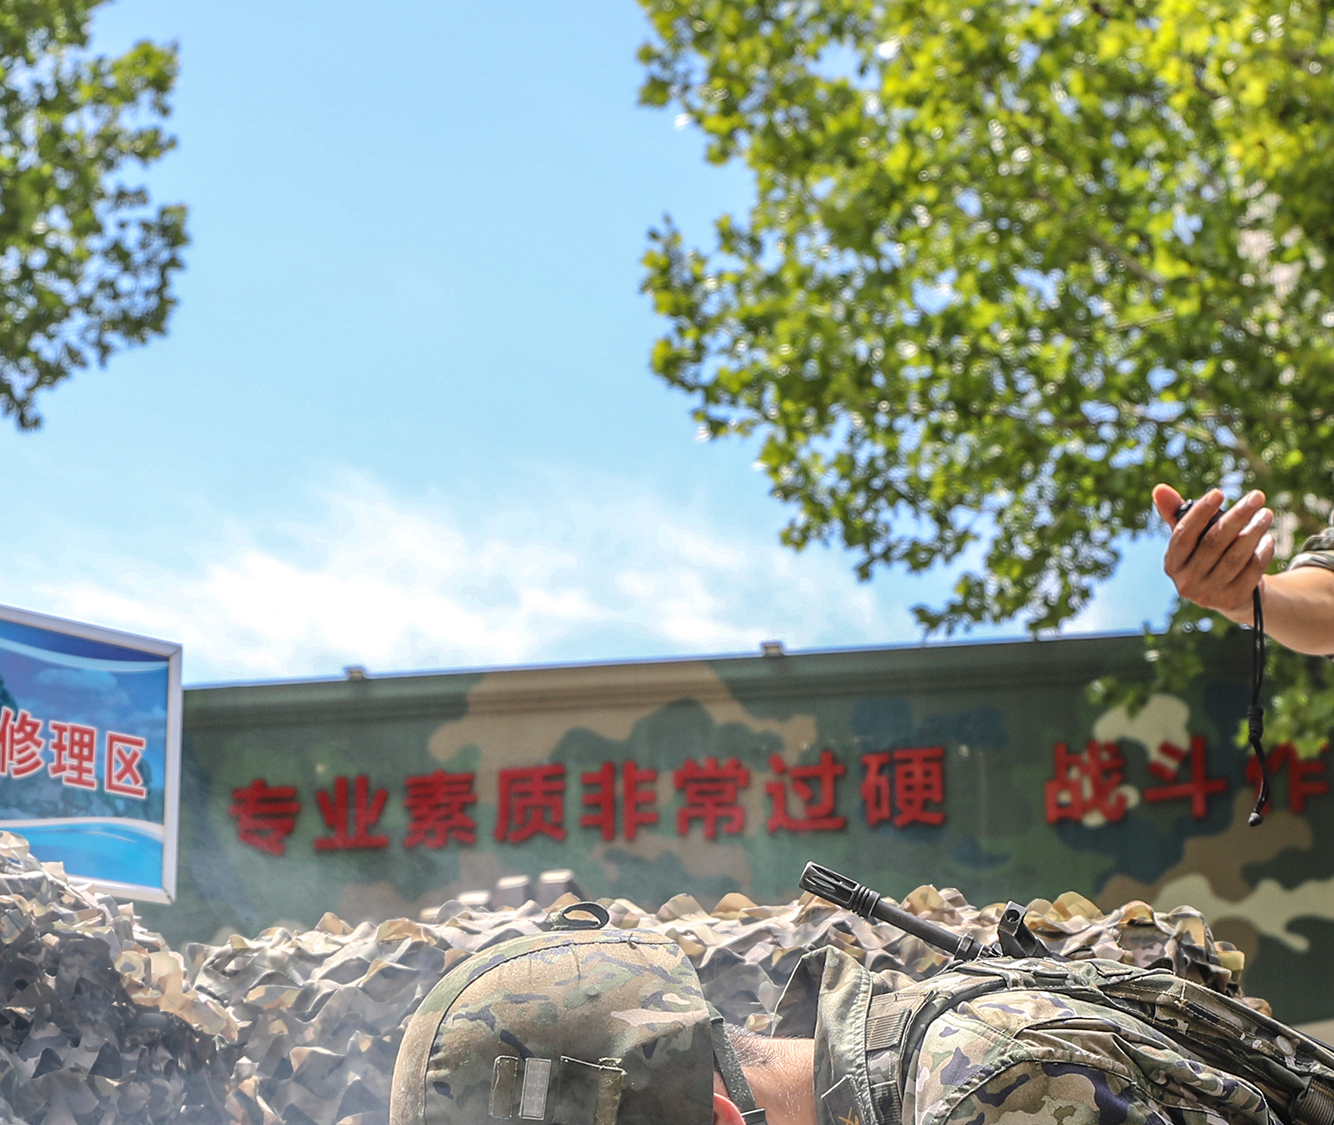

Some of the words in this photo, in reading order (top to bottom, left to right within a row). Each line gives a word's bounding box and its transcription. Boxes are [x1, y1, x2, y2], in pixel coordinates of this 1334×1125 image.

[229, 747, 946, 856] 专业素质非常过硬
